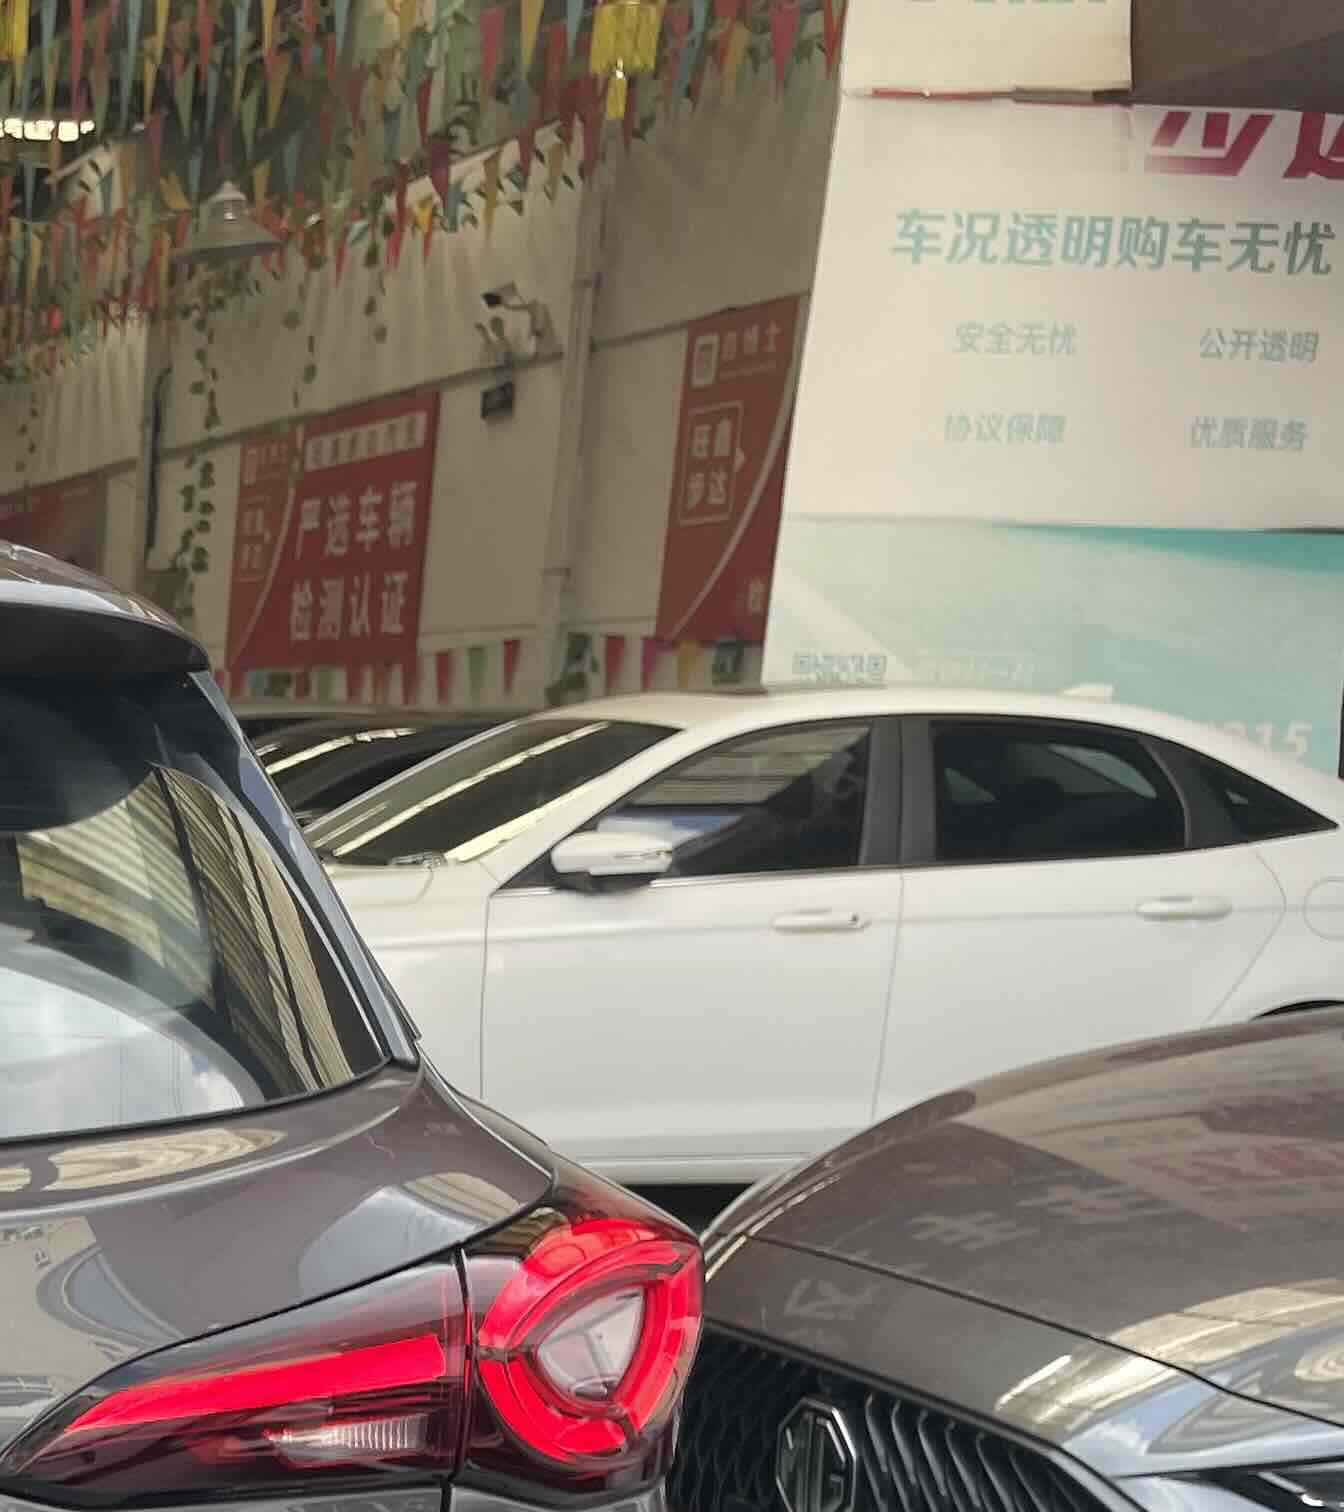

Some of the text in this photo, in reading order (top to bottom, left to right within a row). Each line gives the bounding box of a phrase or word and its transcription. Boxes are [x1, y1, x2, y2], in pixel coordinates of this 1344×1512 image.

[892, 207, 1336, 275] 车况透明购车无忧
[952, 320, 1079, 358] 安全无忧
[1199, 326, 1321, 364] 公开透明
[943, 411, 1069, 446] 协议保障
[1189, 416, 1309, 452] 优质服务
[295, 480, 419, 561] 严选车辆
[288, 569, 410, 642] 检测认证
